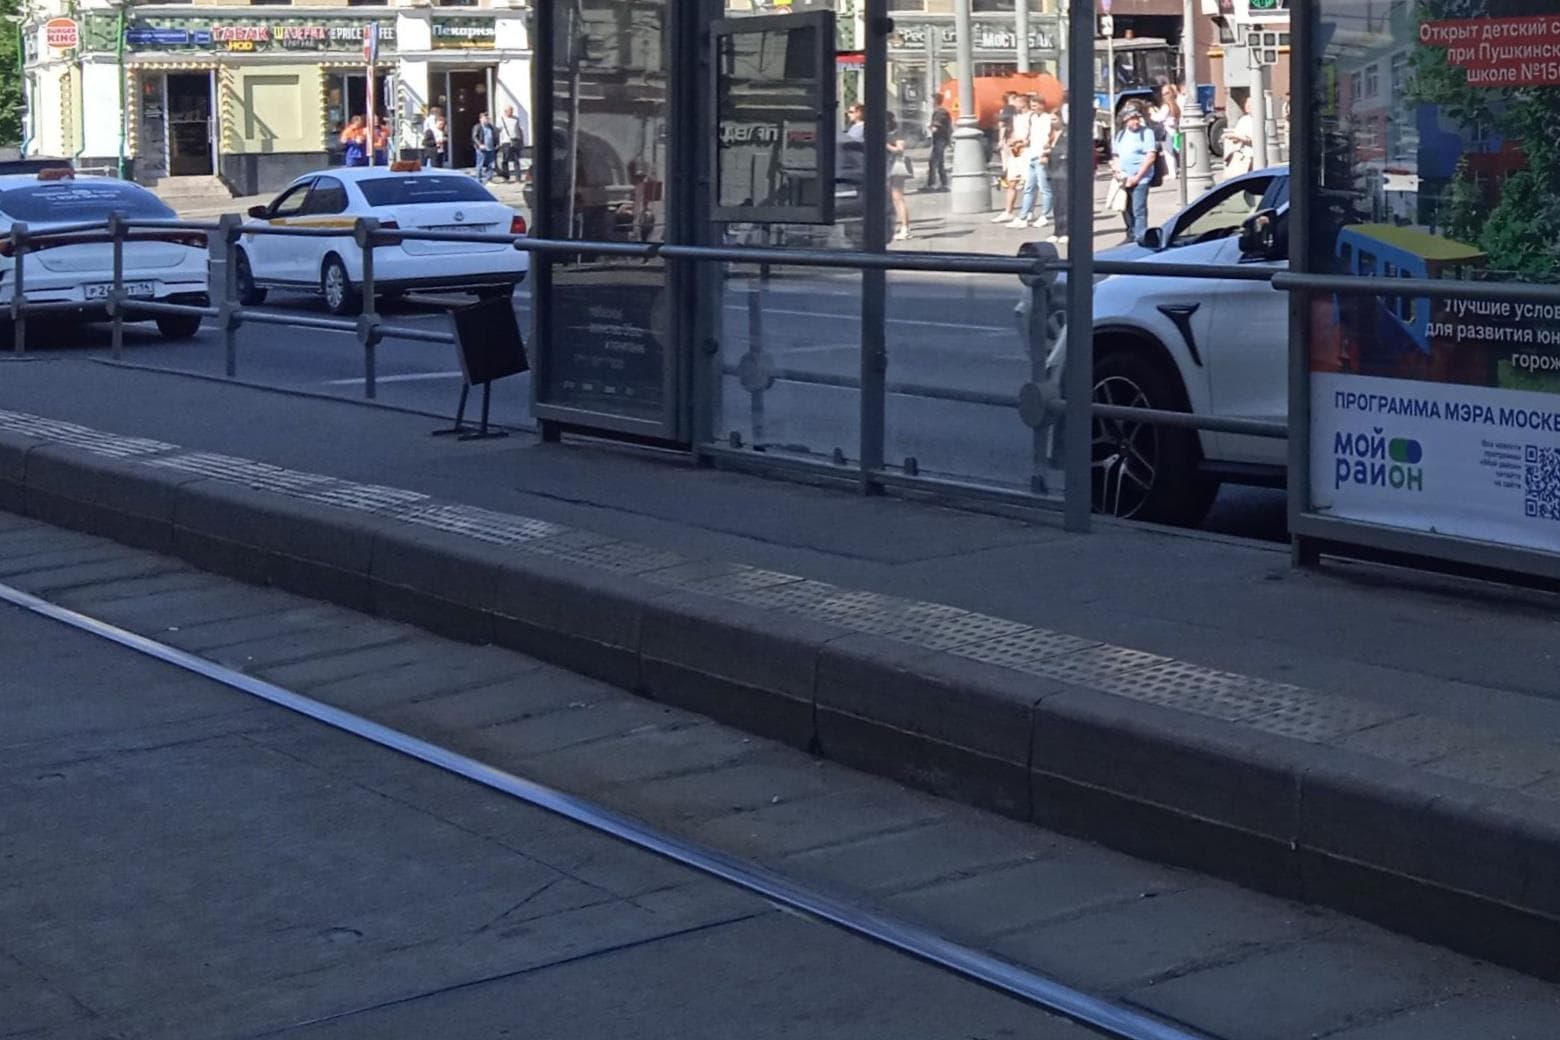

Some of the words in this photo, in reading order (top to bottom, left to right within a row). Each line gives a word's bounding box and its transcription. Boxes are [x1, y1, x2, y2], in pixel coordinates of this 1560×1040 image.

[47, 34, 77, 42] KING
[211, 26, 269, 41] ТАБАК
[432, 25, 496, 39] Пекарня
[1419, 22, 1479, 42] Открыт
[1482, 18, 1547, 40] детский
[982, 32, 1054, 49] МОСТБАК
[1447, 47, 1475, 63] при
[1466, 66, 1517, 82] школе
[1444, 298, 1510, 315] Лучшие
[1425, 321, 1453, 338] для
[1457, 325, 1533, 343] развития
[1335, 391, 1441, 419] ПРОГРАММА
[1445, 403, 1495, 426] МЭРА
